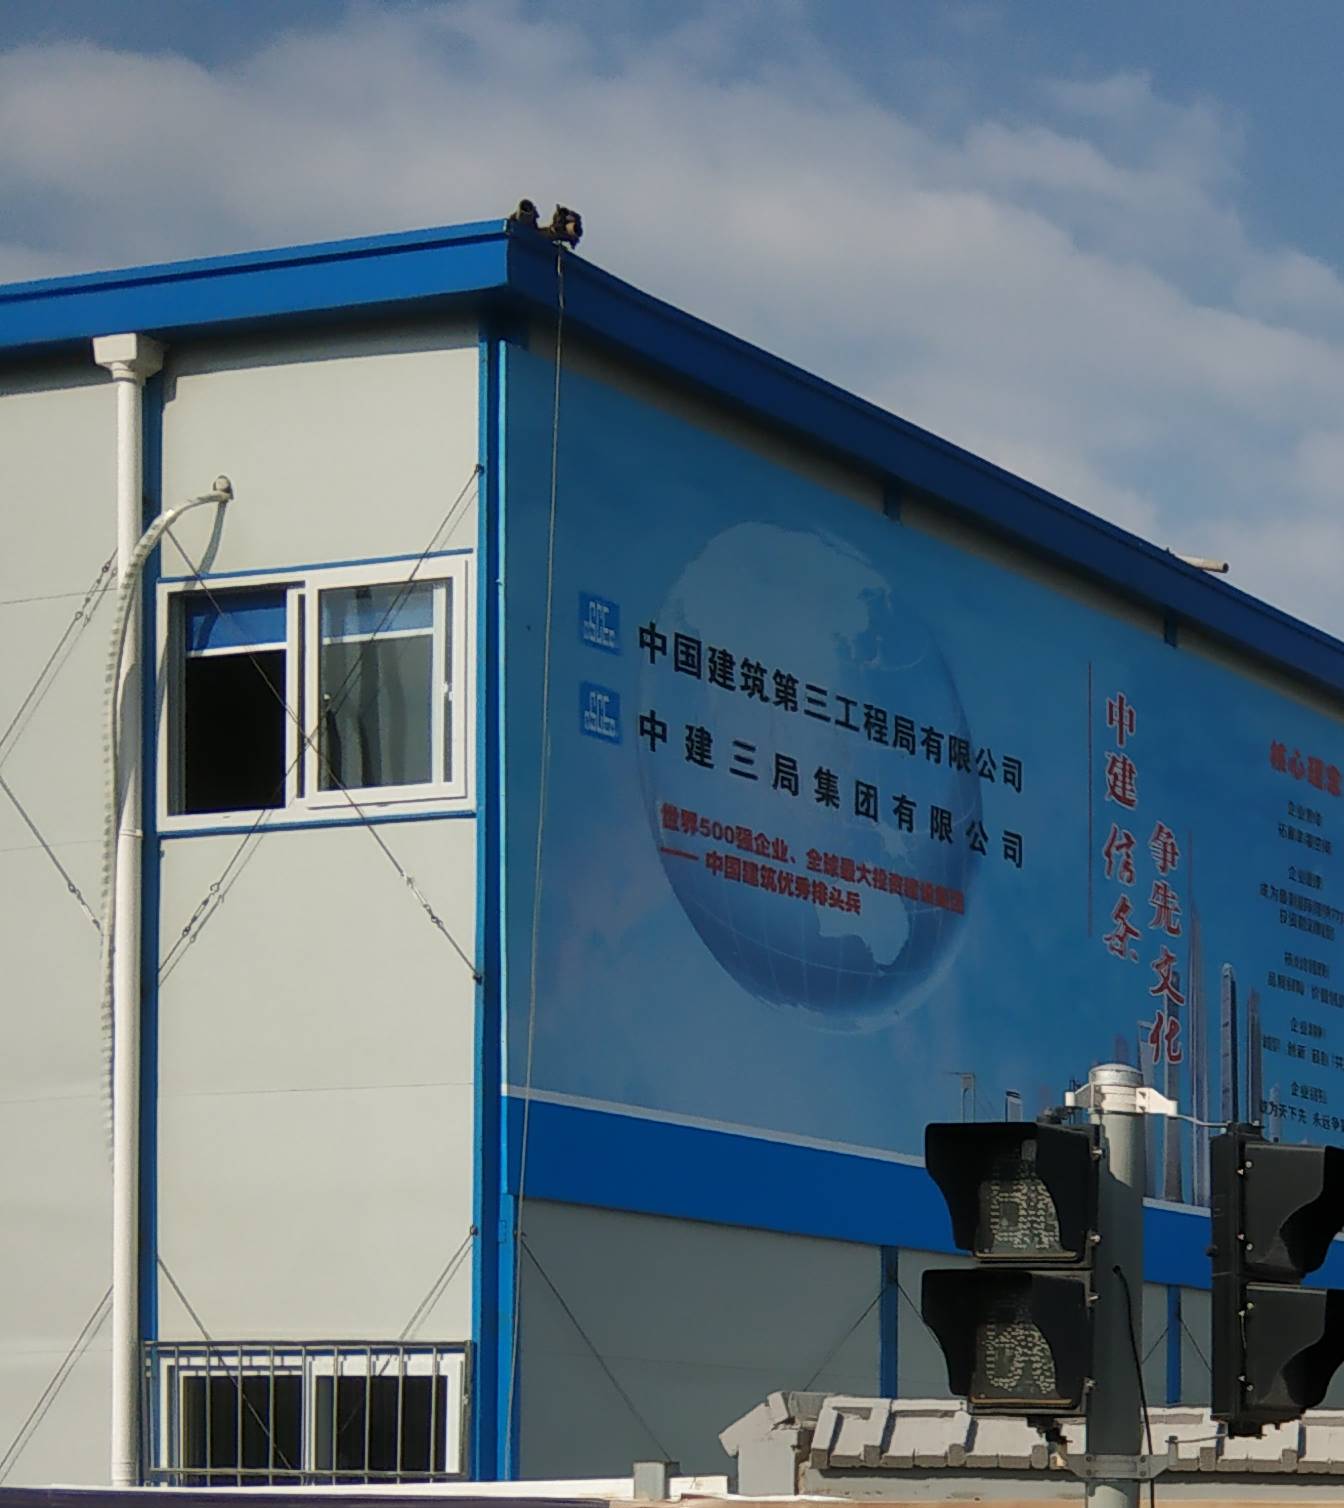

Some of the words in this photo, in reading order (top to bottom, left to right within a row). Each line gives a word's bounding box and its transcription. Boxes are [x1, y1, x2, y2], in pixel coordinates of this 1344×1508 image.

[638, 620, 1024, 793] 中国建筑第三工程局有限公司
[638, 709, 1024, 869] 中建三局集团有限公司
[1103, 691, 1140, 963] 中建信条
[1147, 820, 1186, 1065] 争先文化
